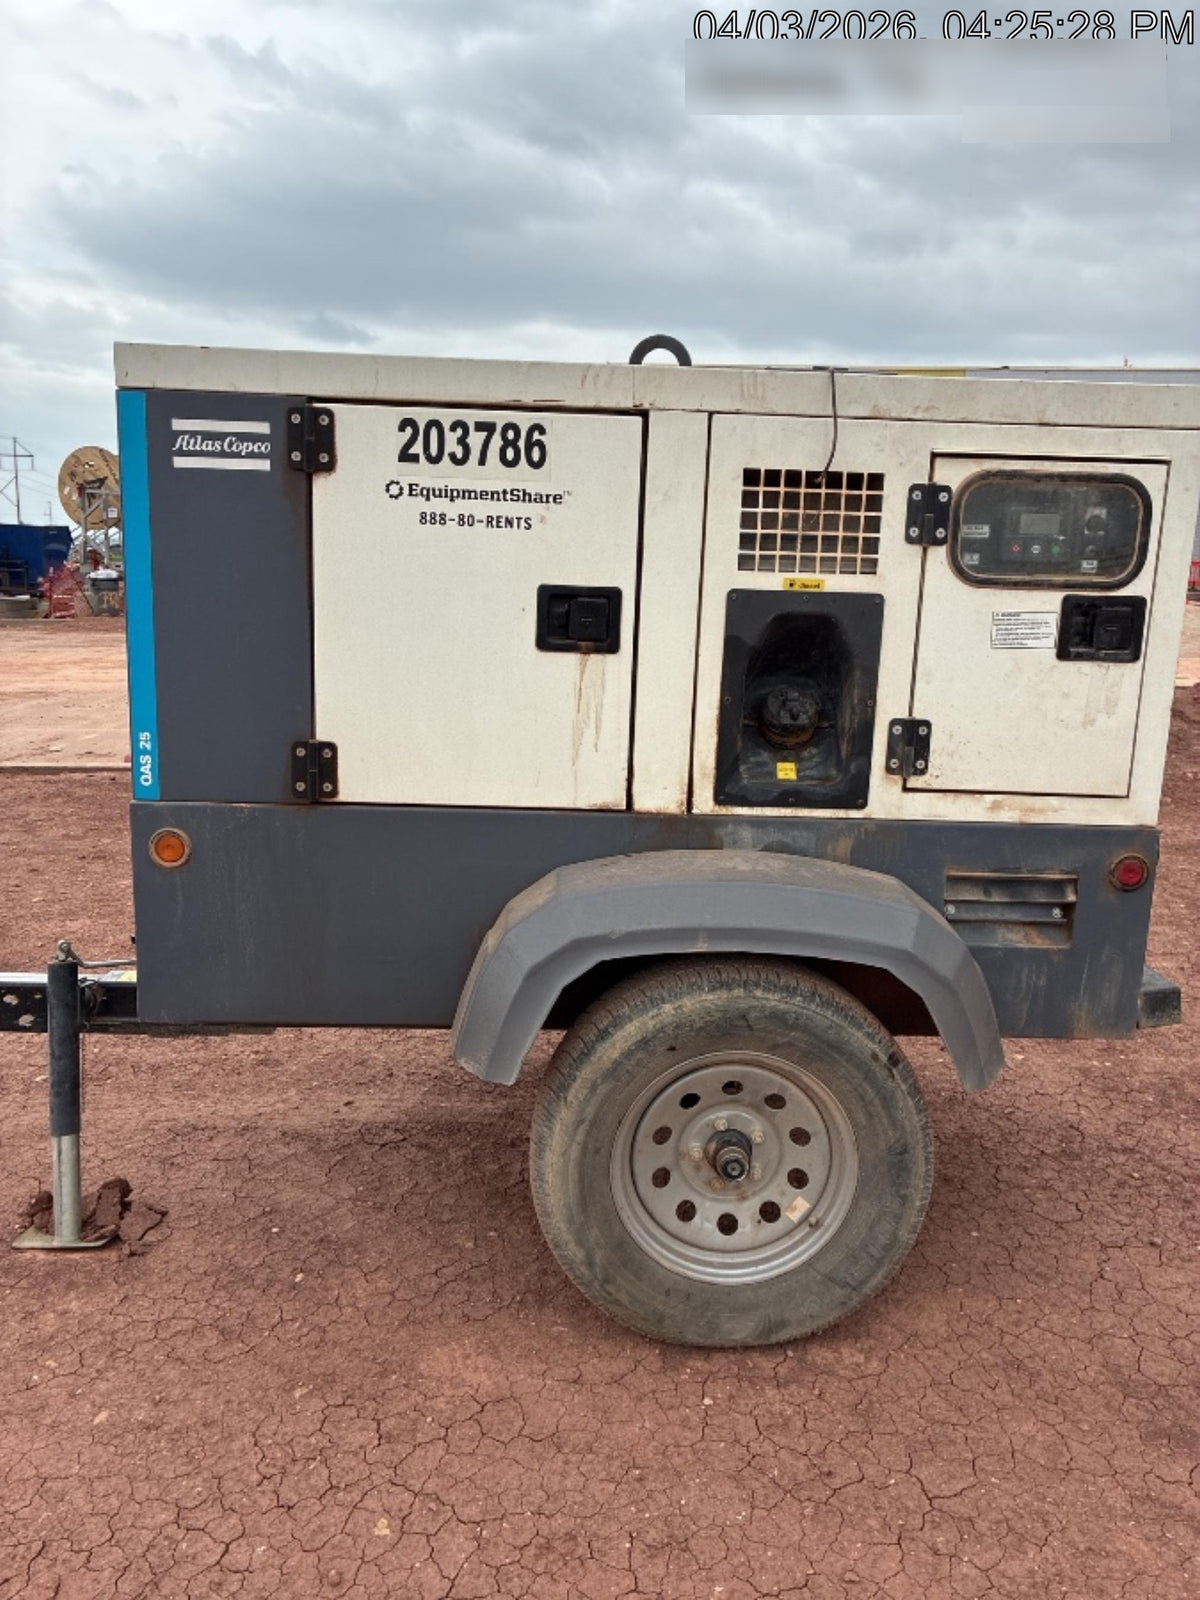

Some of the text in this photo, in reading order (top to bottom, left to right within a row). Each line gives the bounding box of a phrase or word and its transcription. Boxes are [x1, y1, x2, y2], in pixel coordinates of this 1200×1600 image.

[171, 433, 271, 456] Atlas Copco
[397, 417, 548, 470] 203786
[418, 511, 533, 531] 888-80-RENTS
[139, 731, 152, 786] QAS 25
